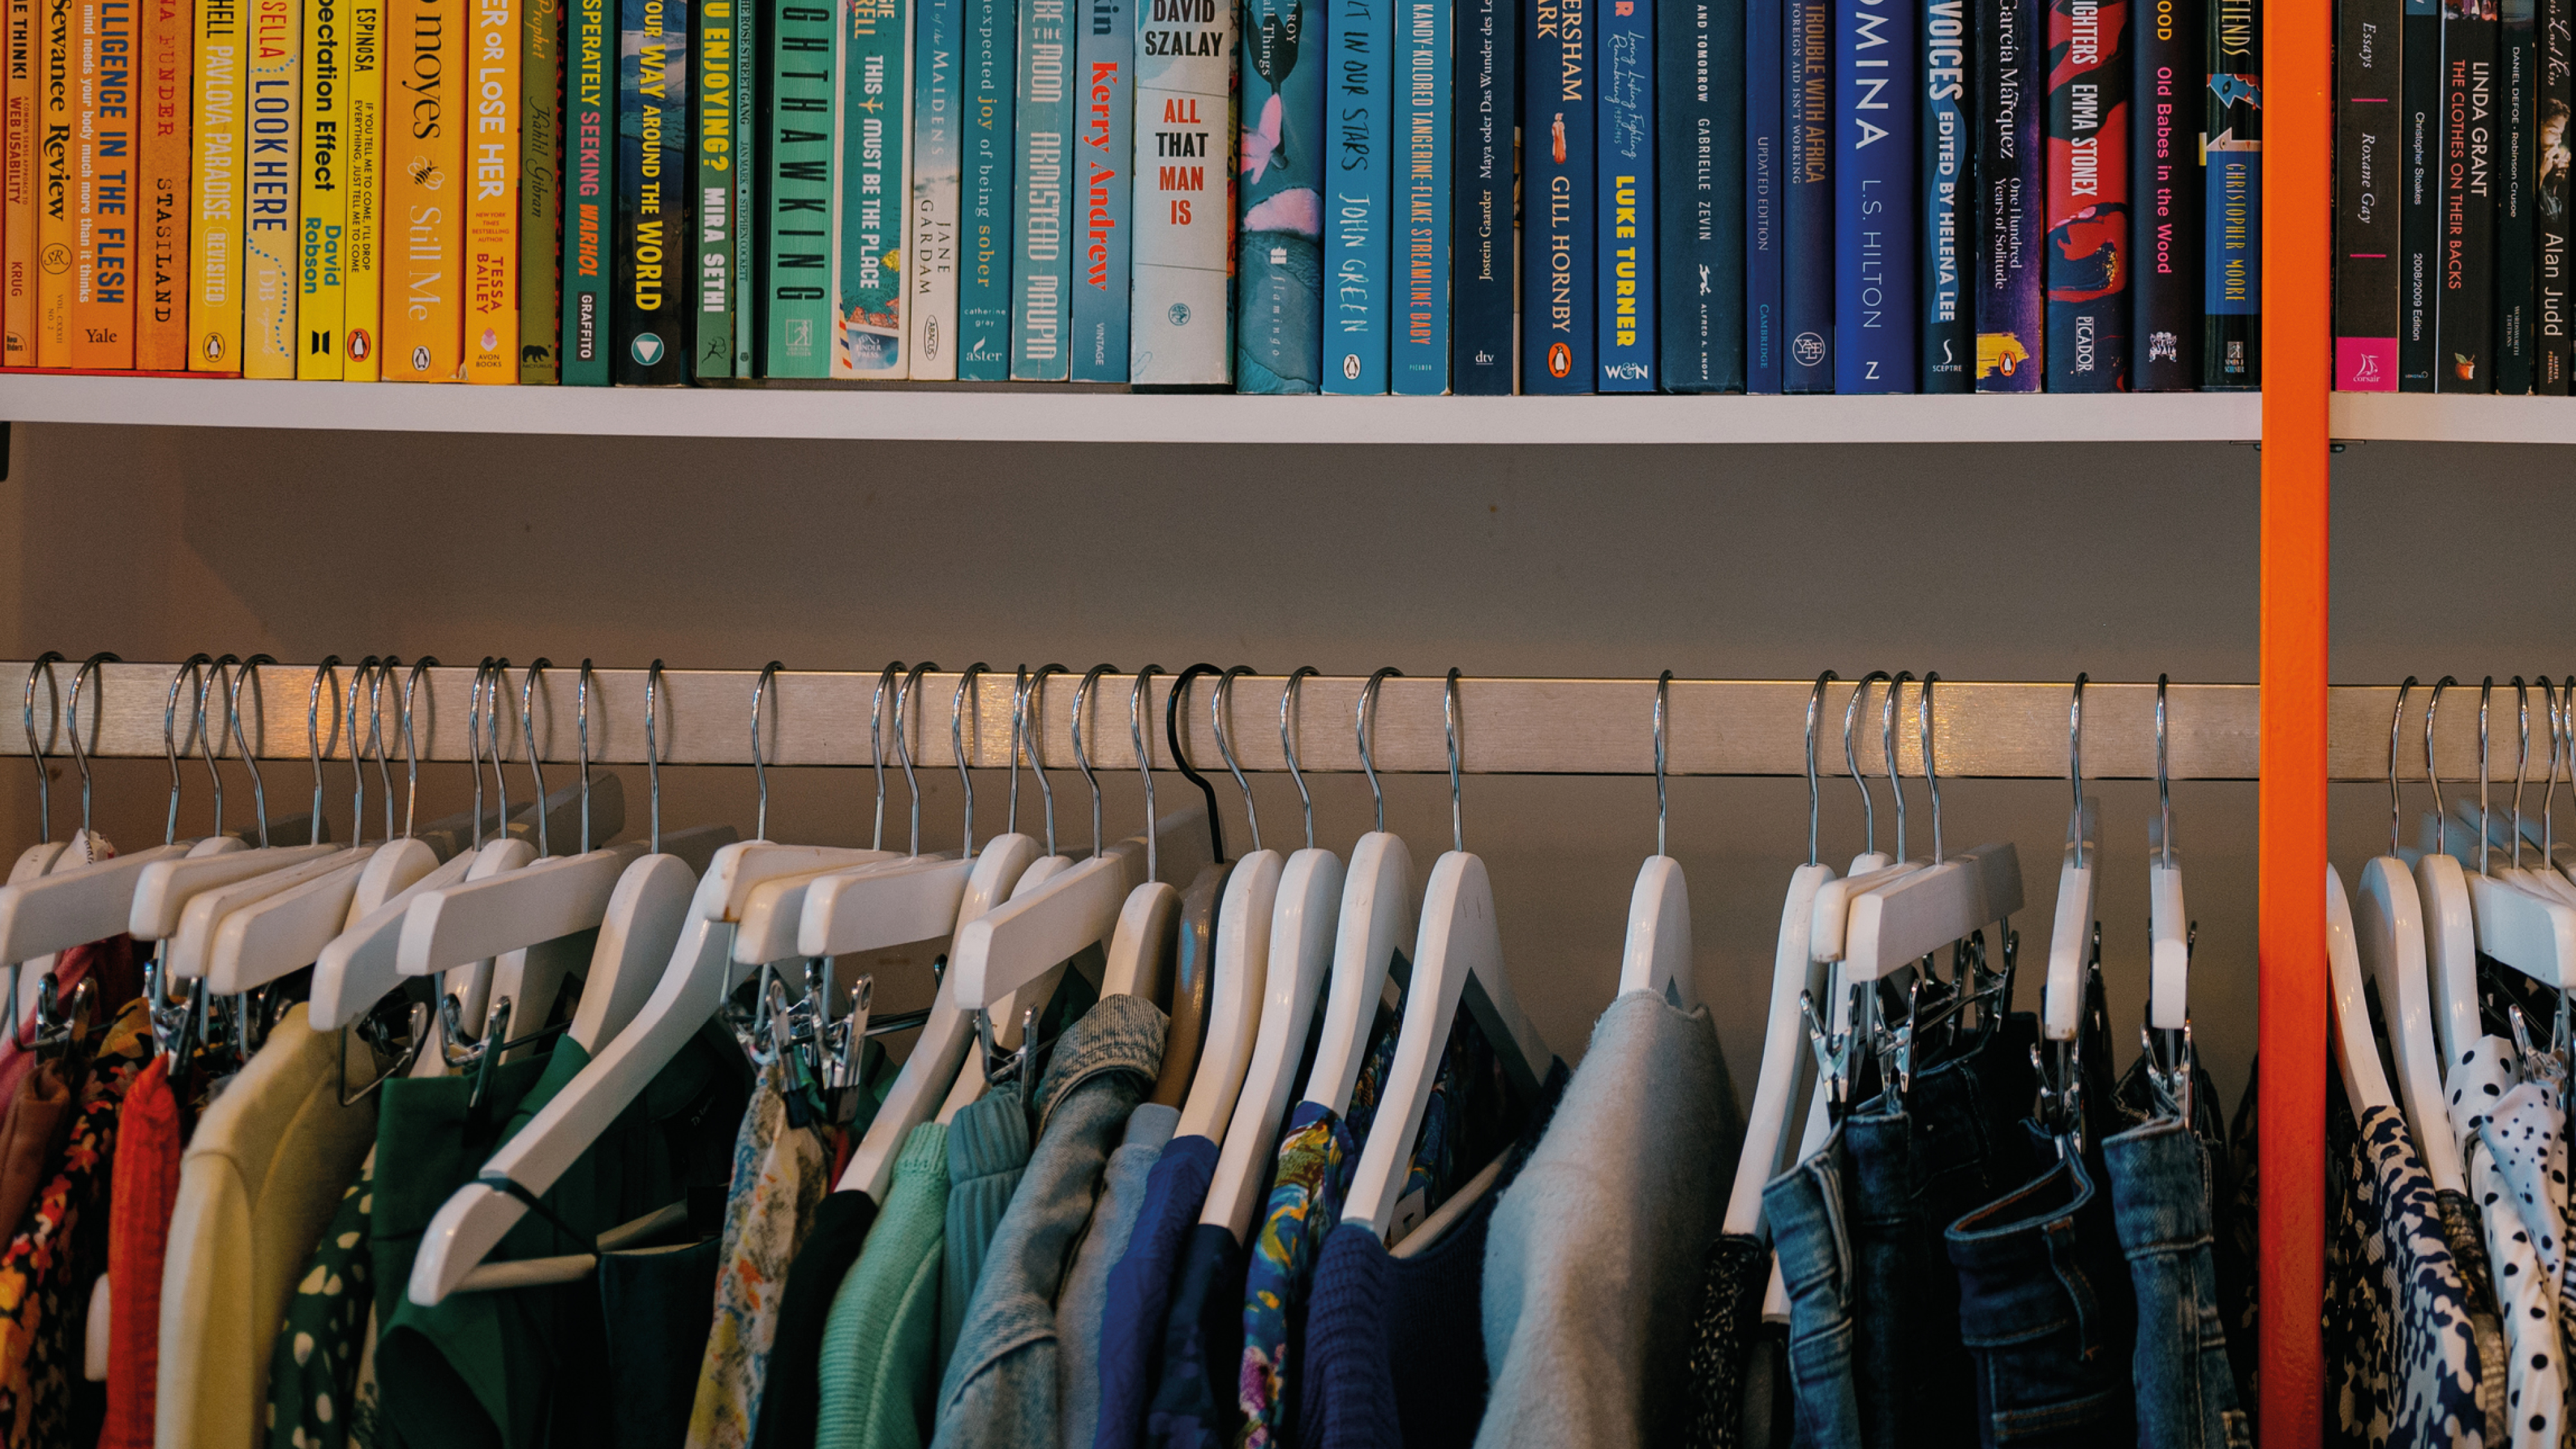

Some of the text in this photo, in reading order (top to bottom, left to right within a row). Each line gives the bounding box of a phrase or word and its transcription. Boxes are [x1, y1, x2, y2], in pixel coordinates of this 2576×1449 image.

[12, 19, 27, 79] THINK!
[354, 8, 376, 72] ESPINOSA
[1145, 31, 1223, 56] SZALAY
[1153, 0, 1215, 22] DAVID
[1929, 1, 1962, 100] VOICES
[2360, 23, 2376, 68] Essays
[158, 35, 175, 137] FUNDER
[740, 16, 750, 125] ROSE STREET GANG
[1164, 99, 1200, 123] ALL
[1479, 17, 1495, 178] Maya oder Das Wunder des
[1792, 88, 1801, 120] ISN'T
[1805, 3, 1825, 183] TROUBLE WITH AFRICA
[9, 97, 21, 204] WEB USABILITY
[44, 124, 71, 222] Review
[79, 5, 95, 303] mind needs your body much more than it thinks
[203, 46, 233, 302] PAVLOVA PARADISE REVISITED
[315, 121, 336, 191] Effect
[353, 100, 363, 162] EVERYTHING,
[703, 28, 730, 312] ENJOYING? MIRA SETHI
[860, 55, 884, 289] THIS MUST BE THE PLACE
[1083, 62, 1117, 291] Kerry Andrew
[1155, 132, 1208, 156] THAT
[1410, 4, 1434, 345] KANDY-KOLORED TANGERINE-FLAKE STREAMLINE BABY
[1792, 125, 1801, 184] WORKING
[2072, 84, 2098, 196] EMMA STONEX
[2157, 67, 2172, 274] Old Babes in the Wood
[2414, 111, 2425, 205] Christopher Stoakes
[2448, 59, 2465, 289] THE CLOTHES ON THEIR BACKS
[2471, 62, 2488, 196] LINDA GRANT
[97, 132, 126, 303] IN THE FLESH
[352, 211, 360, 225] ME
[636, 44, 665, 310] WAY AROUND THE WORLD
[975, 96, 997, 287] joy of being sober
[1159, 166, 1204, 191] MAN
[1171, 200, 1191, 225] IS
[1698, 118, 1711, 240] GABRIELLE ZEVIN
[1939, 111, 1955, 321] EDITED BY HELENA LEE
[2009, 178, 2022, 268] One Hundred
[2358, 133, 2375, 223] Roxane Gay
[11, 262, 23, 296] KRUG
[156, 178, 173, 322] STASILAND
[305, 217, 321, 294] Robson
[325, 225, 341, 285] David
[352, 228, 359, 241] TO
[408, 205, 441, 321] Still Me
[578, 111, 600, 358] SEEKING WARHOL GRAFFITO
[919, 200, 933, 294] GARDAM
[936, 222, 951, 273] JANE
[1027, 132, 1061, 359] ARMISTEAD MAUPIN
[1338, 193, 1370, 332] JOHN GREEN
[1479, 190, 1493, 281] Jostein Gaarder
[1551, 176, 1570, 333] GILL HORNBY
[1616, 176, 1635, 346] LUKE TURNER
[1862, 232, 1882, 327] HILTON
[1995, 178, 2007, 289] Years of Solitude
[2225, 164, 2246, 301] CHRISTOPHER MOORE
[477, 254, 489, 314] BAILEY
[491, 256, 503, 310] TESSA
[2412, 253, 2423, 341] 2008/2009 Edition
[2544, 232, 2564, 336] Alan Judd
[85, 328, 118, 343] Yale
[927, 322, 936, 355] ABACUS
[1096, 323, 1104, 365] VINTAGE
[1475, 350, 1494, 363] dtv
[2078, 316, 2092, 370] PICADOR
